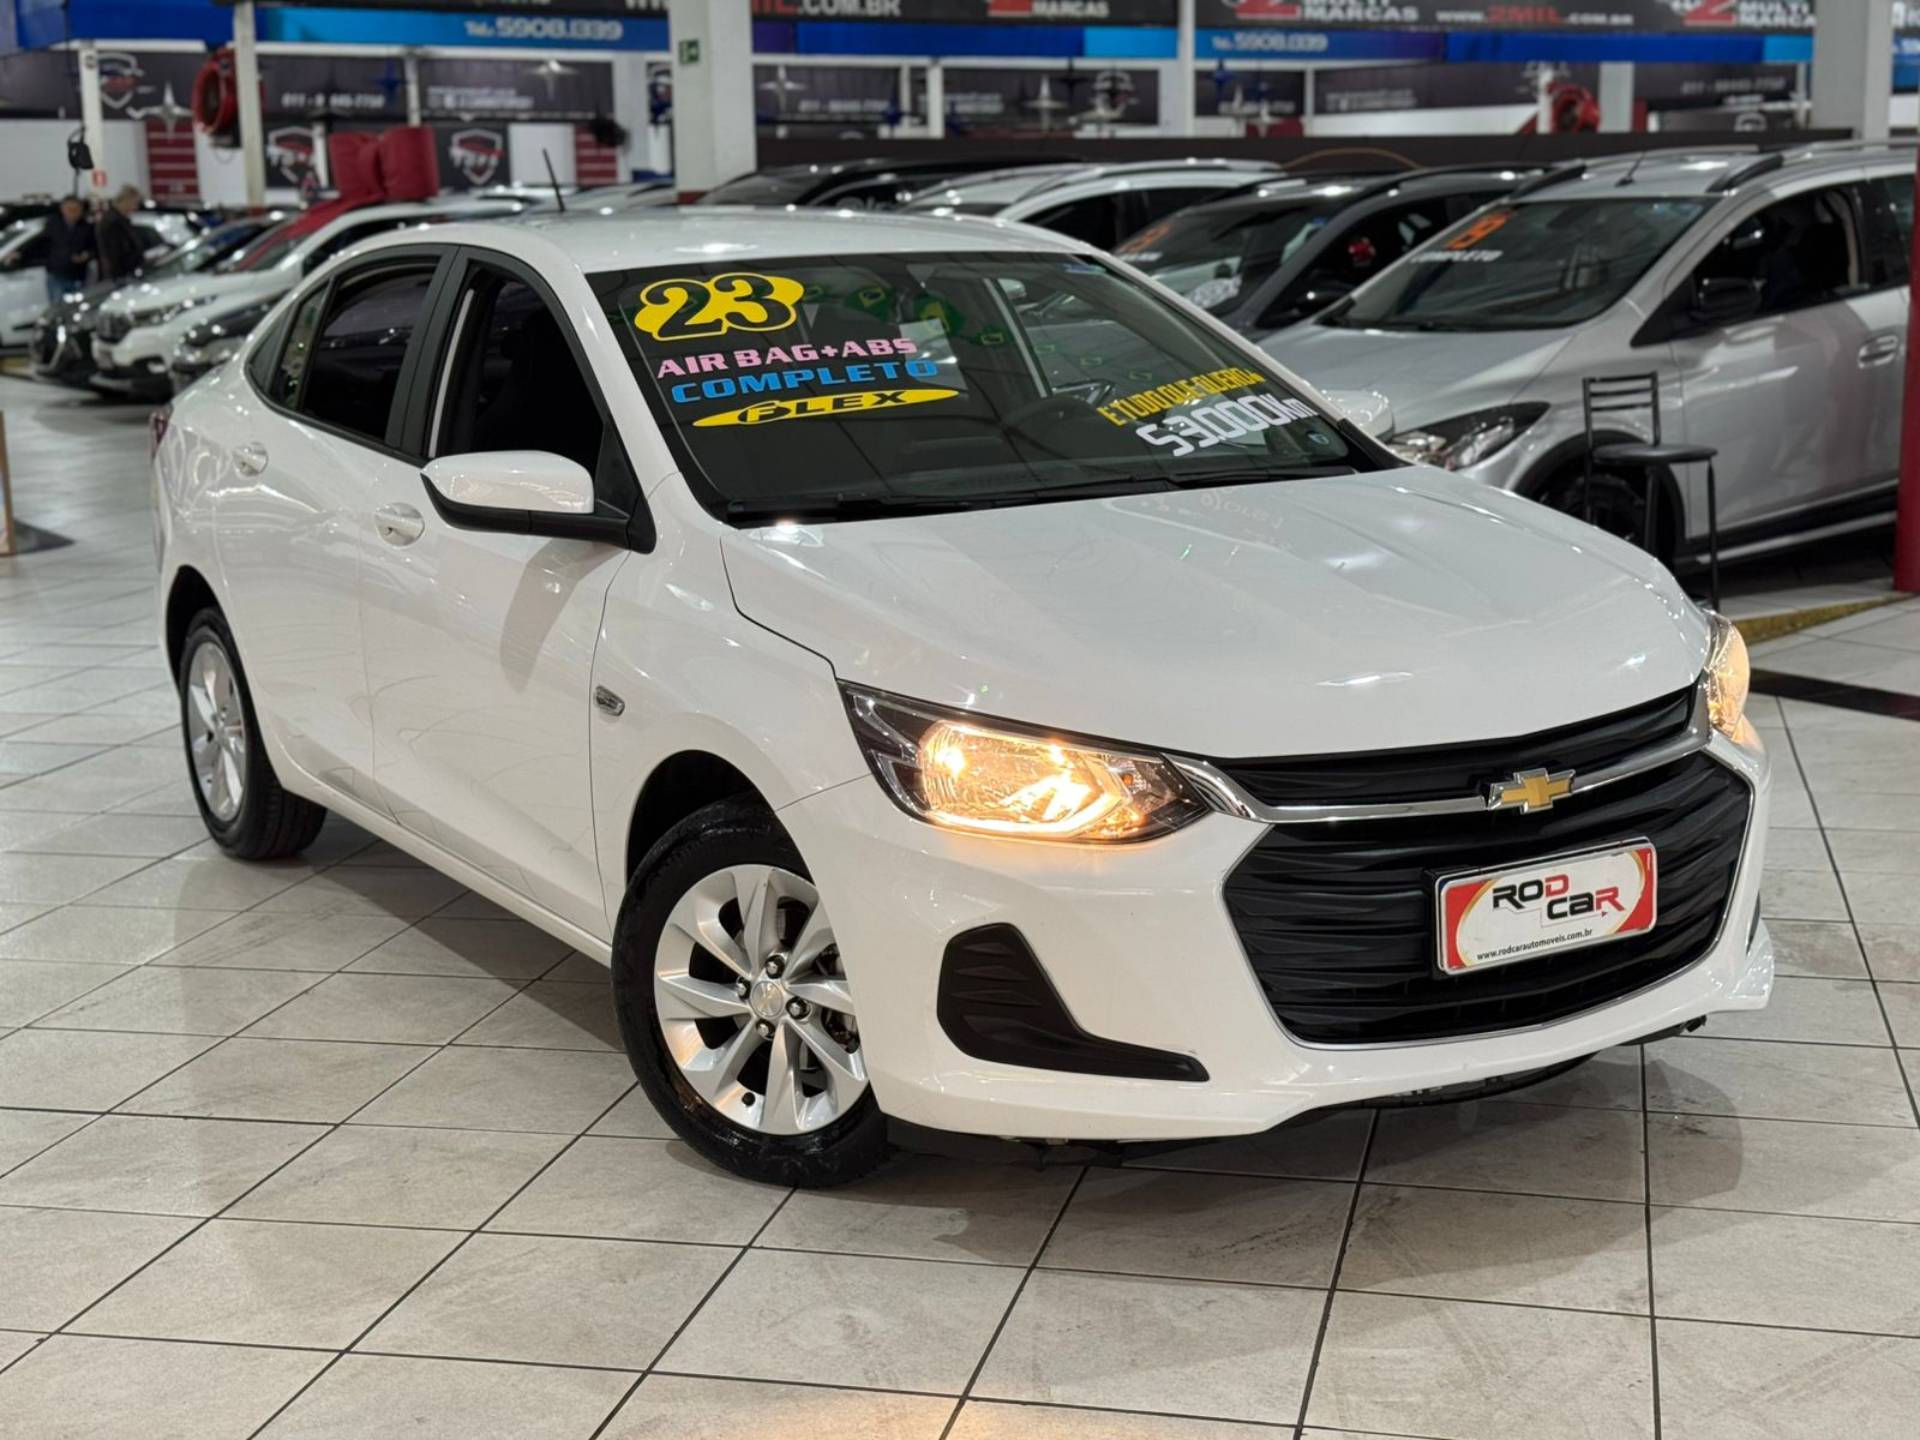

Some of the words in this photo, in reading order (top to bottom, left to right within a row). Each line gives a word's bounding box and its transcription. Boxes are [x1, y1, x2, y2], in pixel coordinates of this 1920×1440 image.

[1303, 6, 1419, 21] MARCAS
[641, 272, 797, 341] 23
[657, 352, 729, 379] AIR
[733, 337, 918, 368] BAG+ABS
[671, 359, 939, 404] COMPLETO
[739, 390, 907, 424] FLEX
[1492, 874, 1569, 910] ROD
[1477, 928, 1593, 961] www.rodcarautomoveis.com.br
